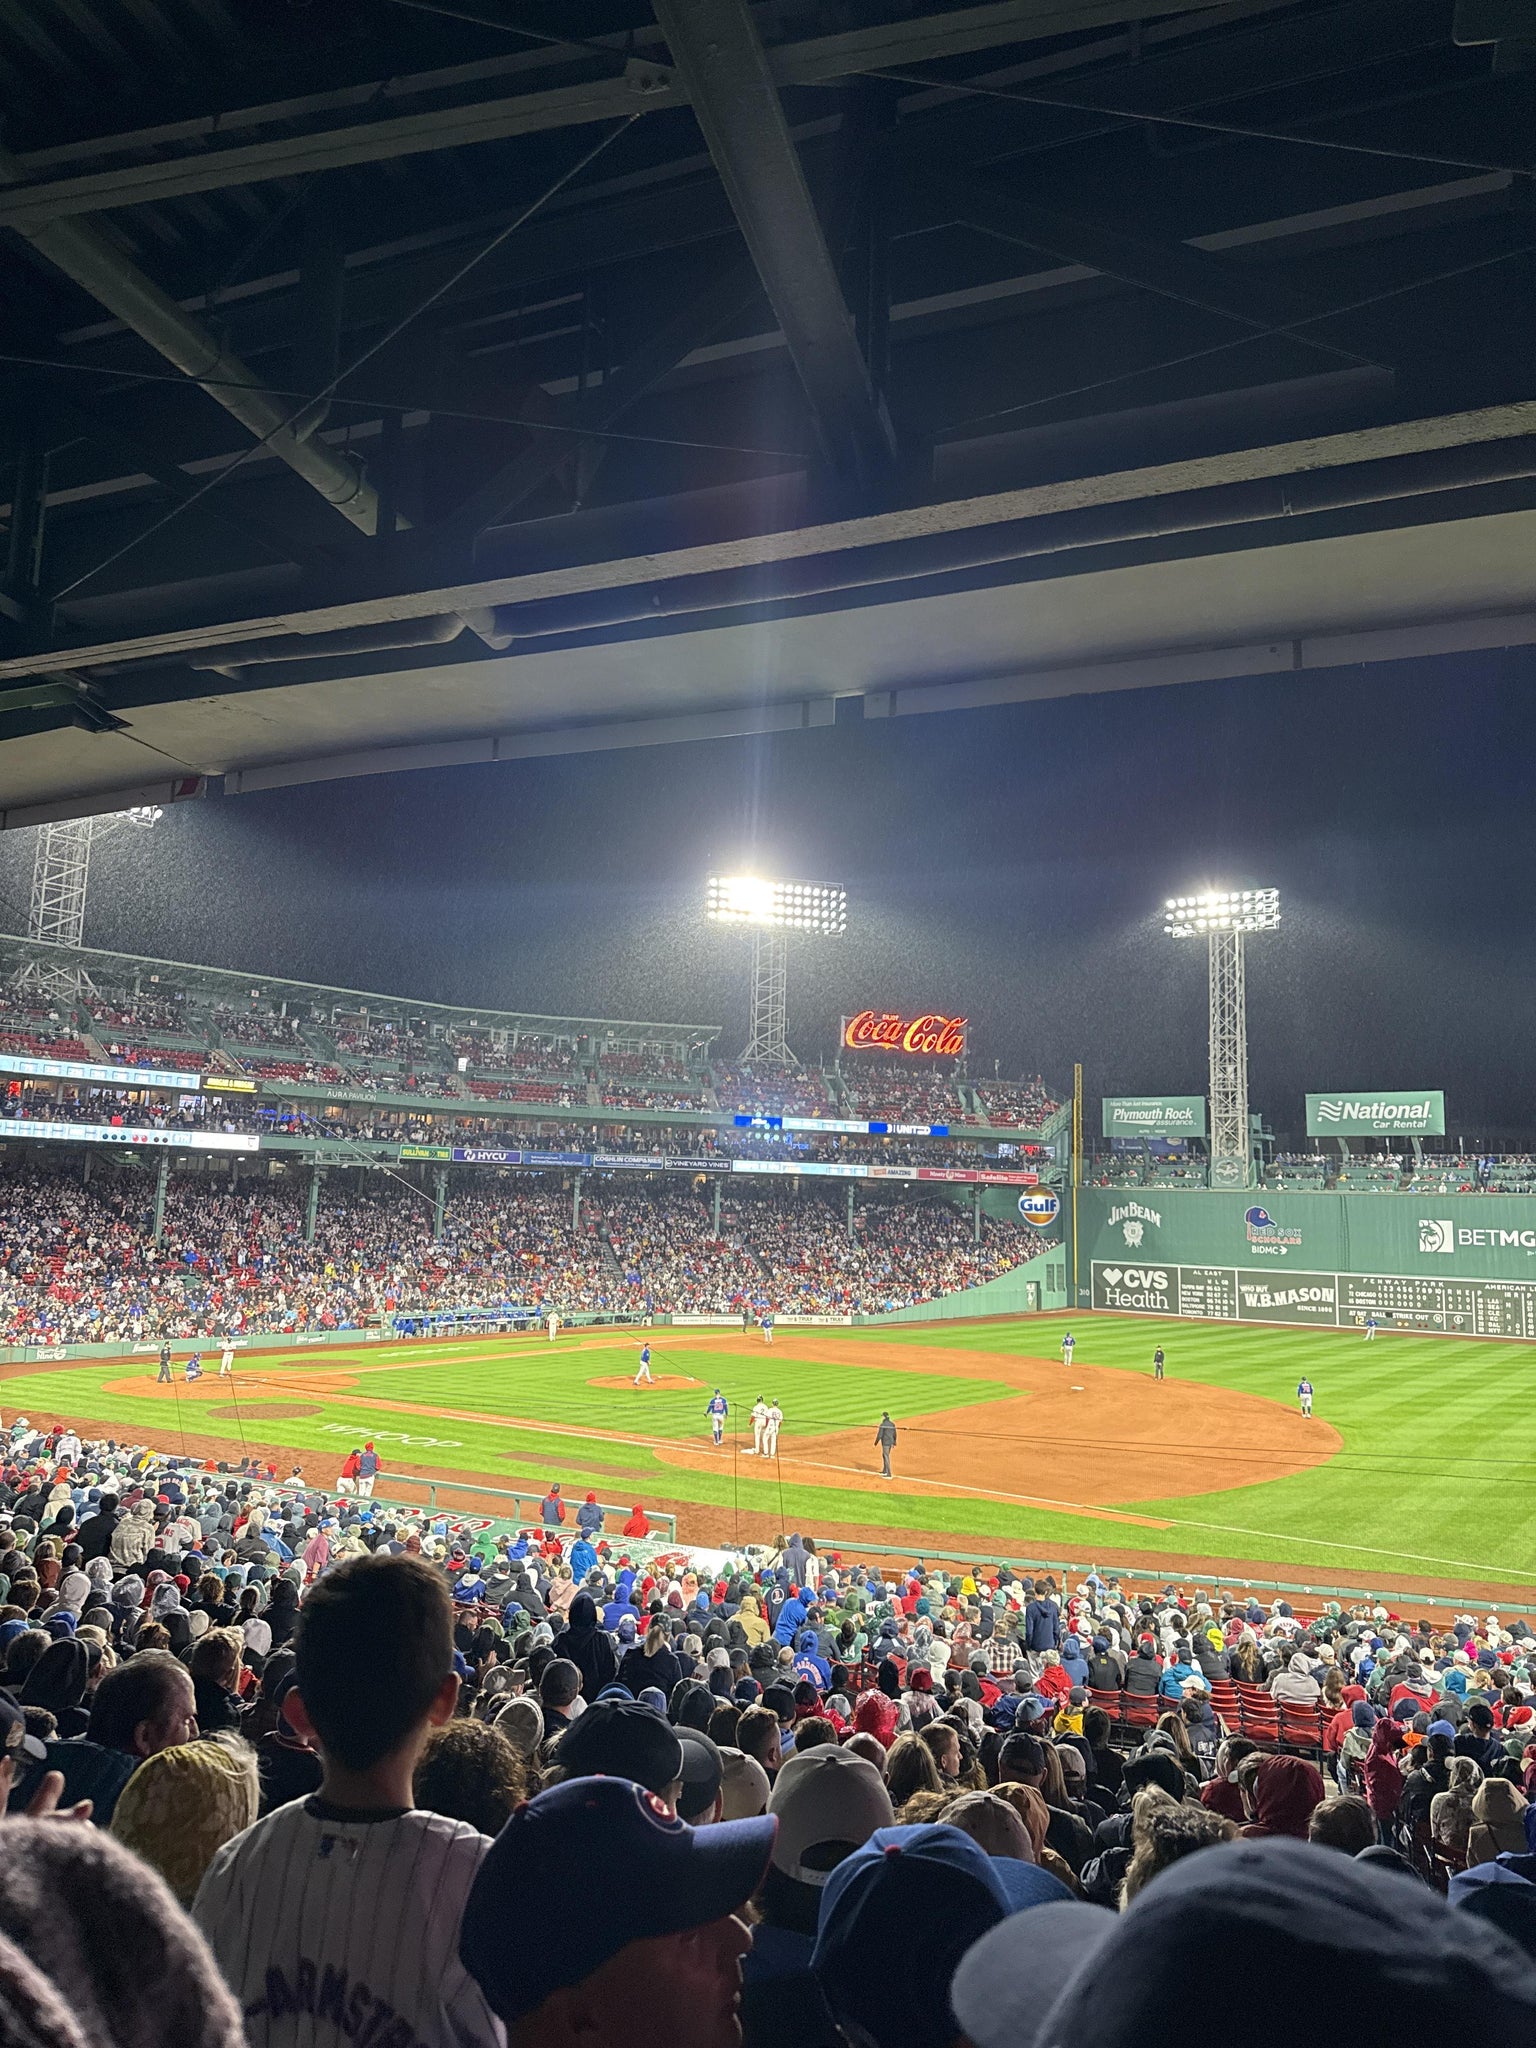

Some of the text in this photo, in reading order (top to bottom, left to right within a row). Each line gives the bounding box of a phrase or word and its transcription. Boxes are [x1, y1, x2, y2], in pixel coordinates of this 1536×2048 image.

[1113, 1107, 1194, 1121] Plymouth Rock
[897, 1124, 931, 1135] UNITED
[1373, 1120, 1427, 1129] Car Rental
[478, 1151, 506, 1160] HYCU
[1020, 1199, 1057, 1212] Gulf
[1108, 1201, 1162, 1228] JIM BEAM
[1251, 1227, 1302, 1237] RED SOX
[1251, 1236, 1302, 1245] SCHOLARS
[1251, 1245, 1279, 1255] BIDMC
[1123, 1269, 1169, 1290] CVS
[1363, 1278, 1445, 1288] FENWAY PARK
[1079, 1288, 1090, 1296] 310
[1105, 1287, 1169, 1310] Health
[316, 1423, 464, 1448] WHOOP
